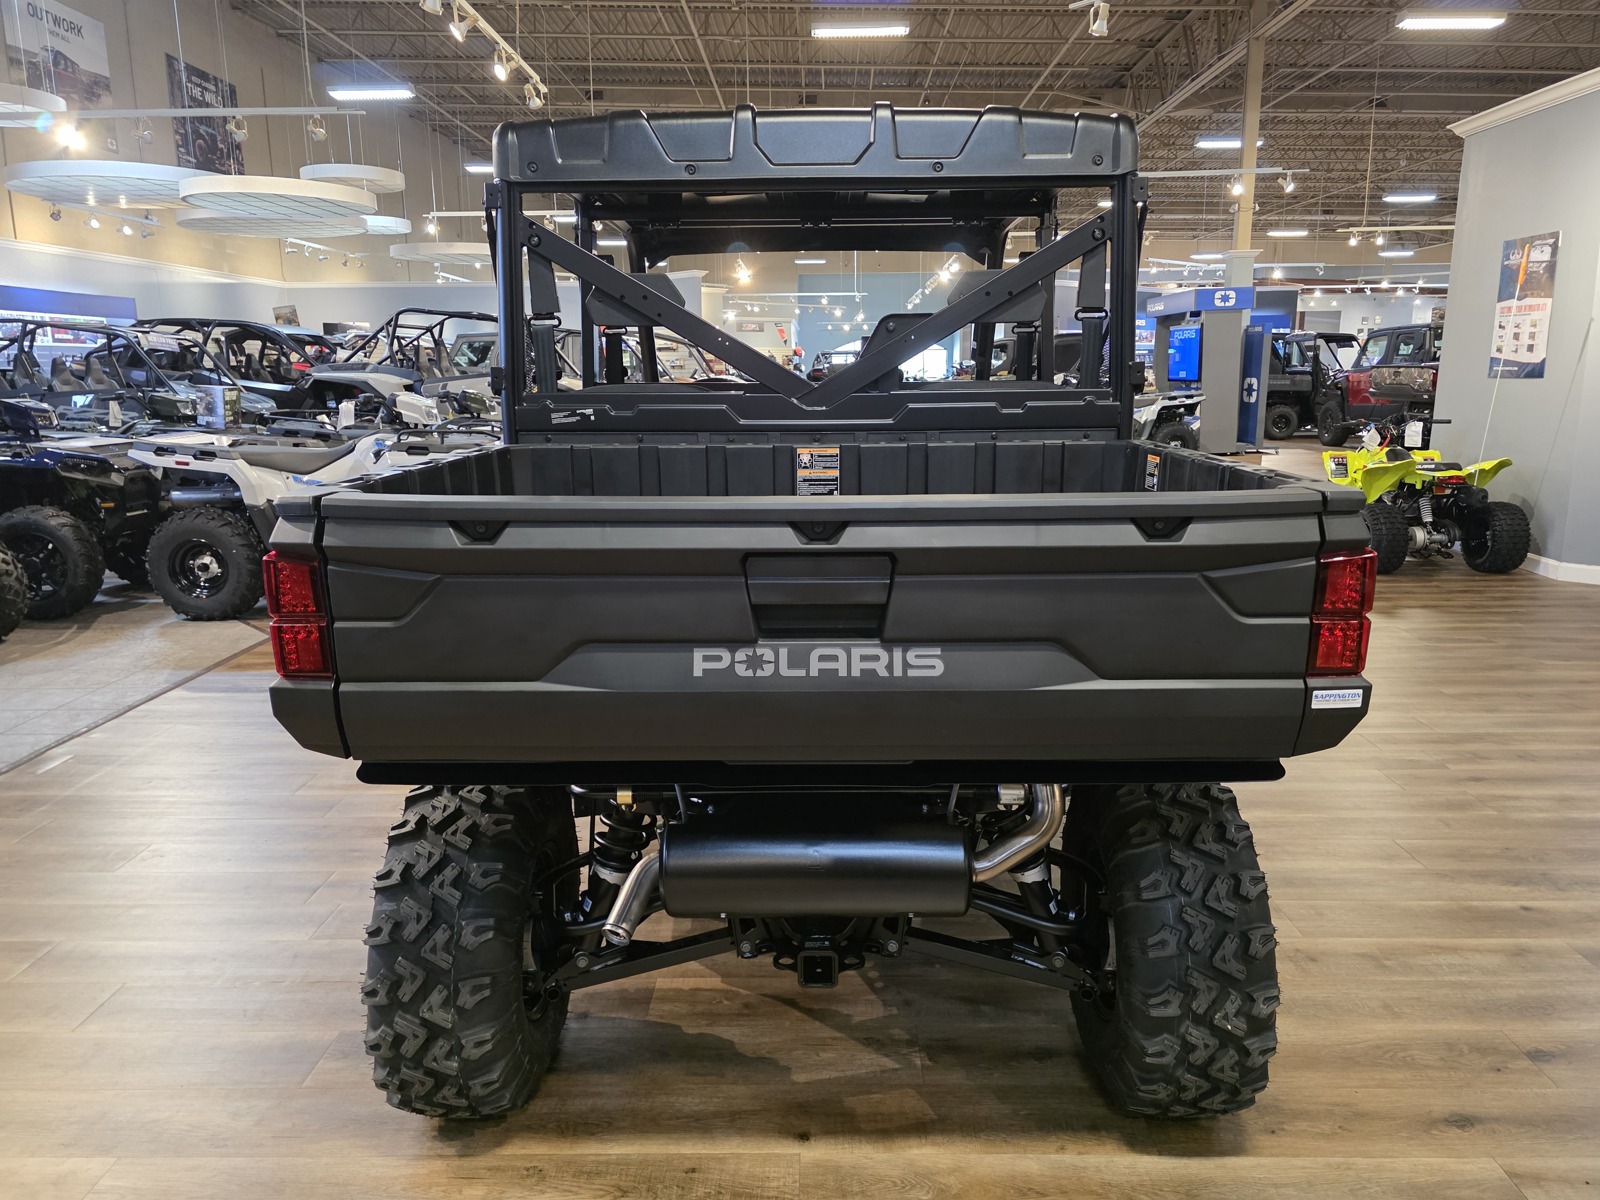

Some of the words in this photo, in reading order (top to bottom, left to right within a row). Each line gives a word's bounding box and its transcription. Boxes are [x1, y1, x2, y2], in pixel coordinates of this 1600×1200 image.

[27, 2, 84, 39] OUTWORK
[47, 28, 60, 38] HEM
[186, 82, 203, 100] THE
[203, 89, 223, 108] WILD
[1146, 302, 1165, 312] POLARIS
[1174, 329, 1196, 339] POLARIS
[693, 647, 945, 677] POLARIS
[1313, 692, 1361, 700] SAPPINGTON
